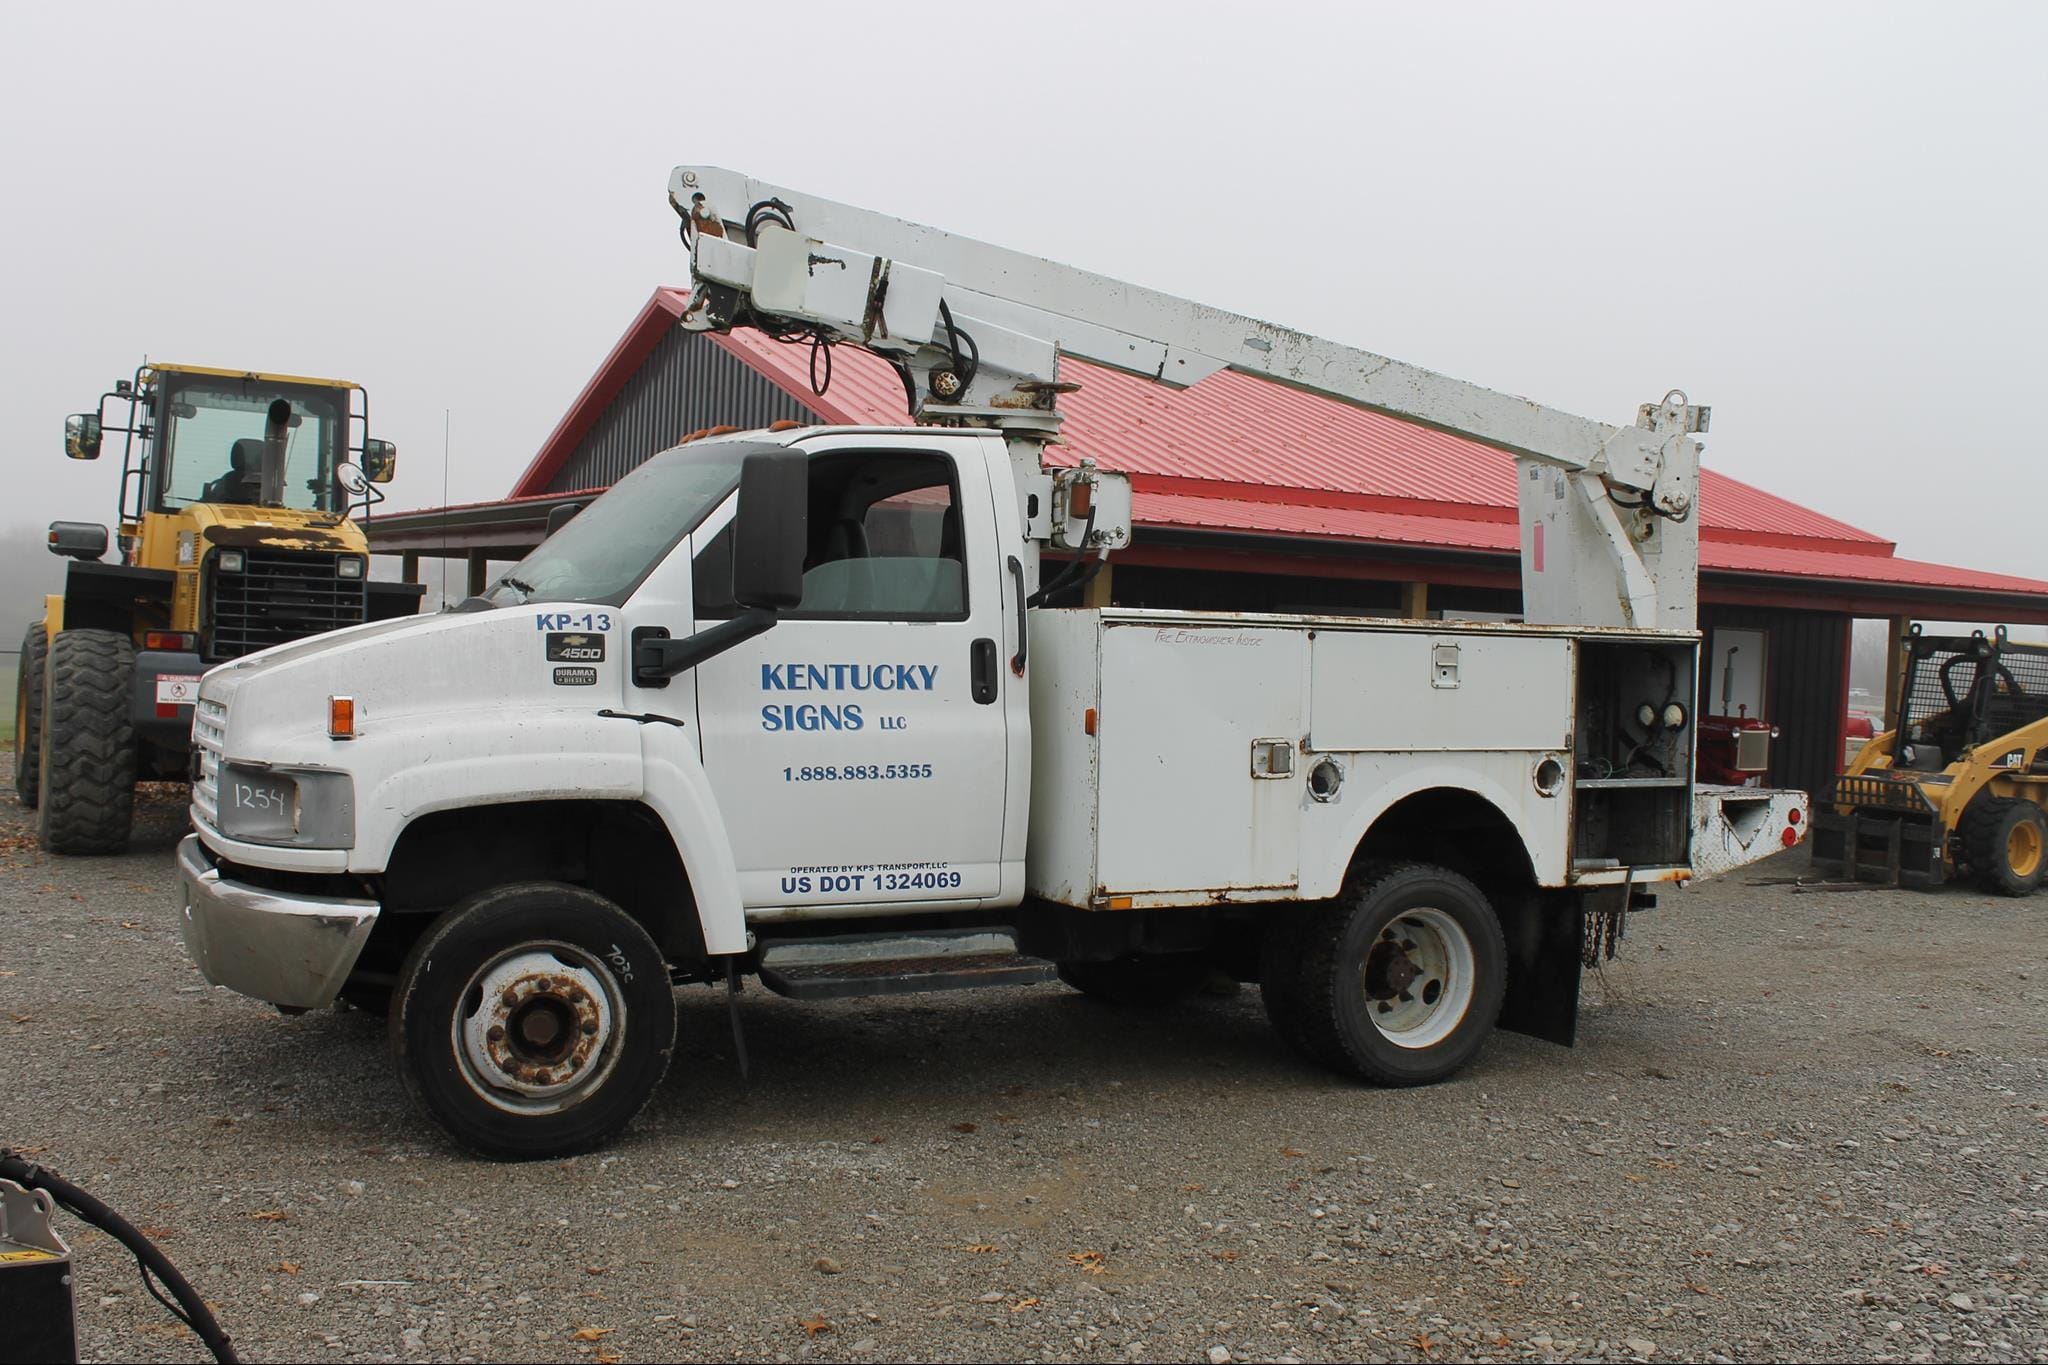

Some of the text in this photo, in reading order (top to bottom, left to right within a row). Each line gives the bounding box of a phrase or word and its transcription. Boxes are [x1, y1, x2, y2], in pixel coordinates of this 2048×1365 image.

[536, 613, 611, 632] KP-13
[555, 668, 595, 677] DURAMAX
[761, 663, 939, 691] KENTUCKY
[761, 704, 907, 731] SIGNS LLC
[2007, 753, 2023, 769] CAT
[783, 763, 933, 782] 1.888.883.5355
[235, 783, 285, 816] 1254
[790, 865, 838, 874] OPERATED
[841, 865, 853, 873] BY
[856, 864, 874, 872] KPS
[781, 871, 962, 894] US DOT 1324069
